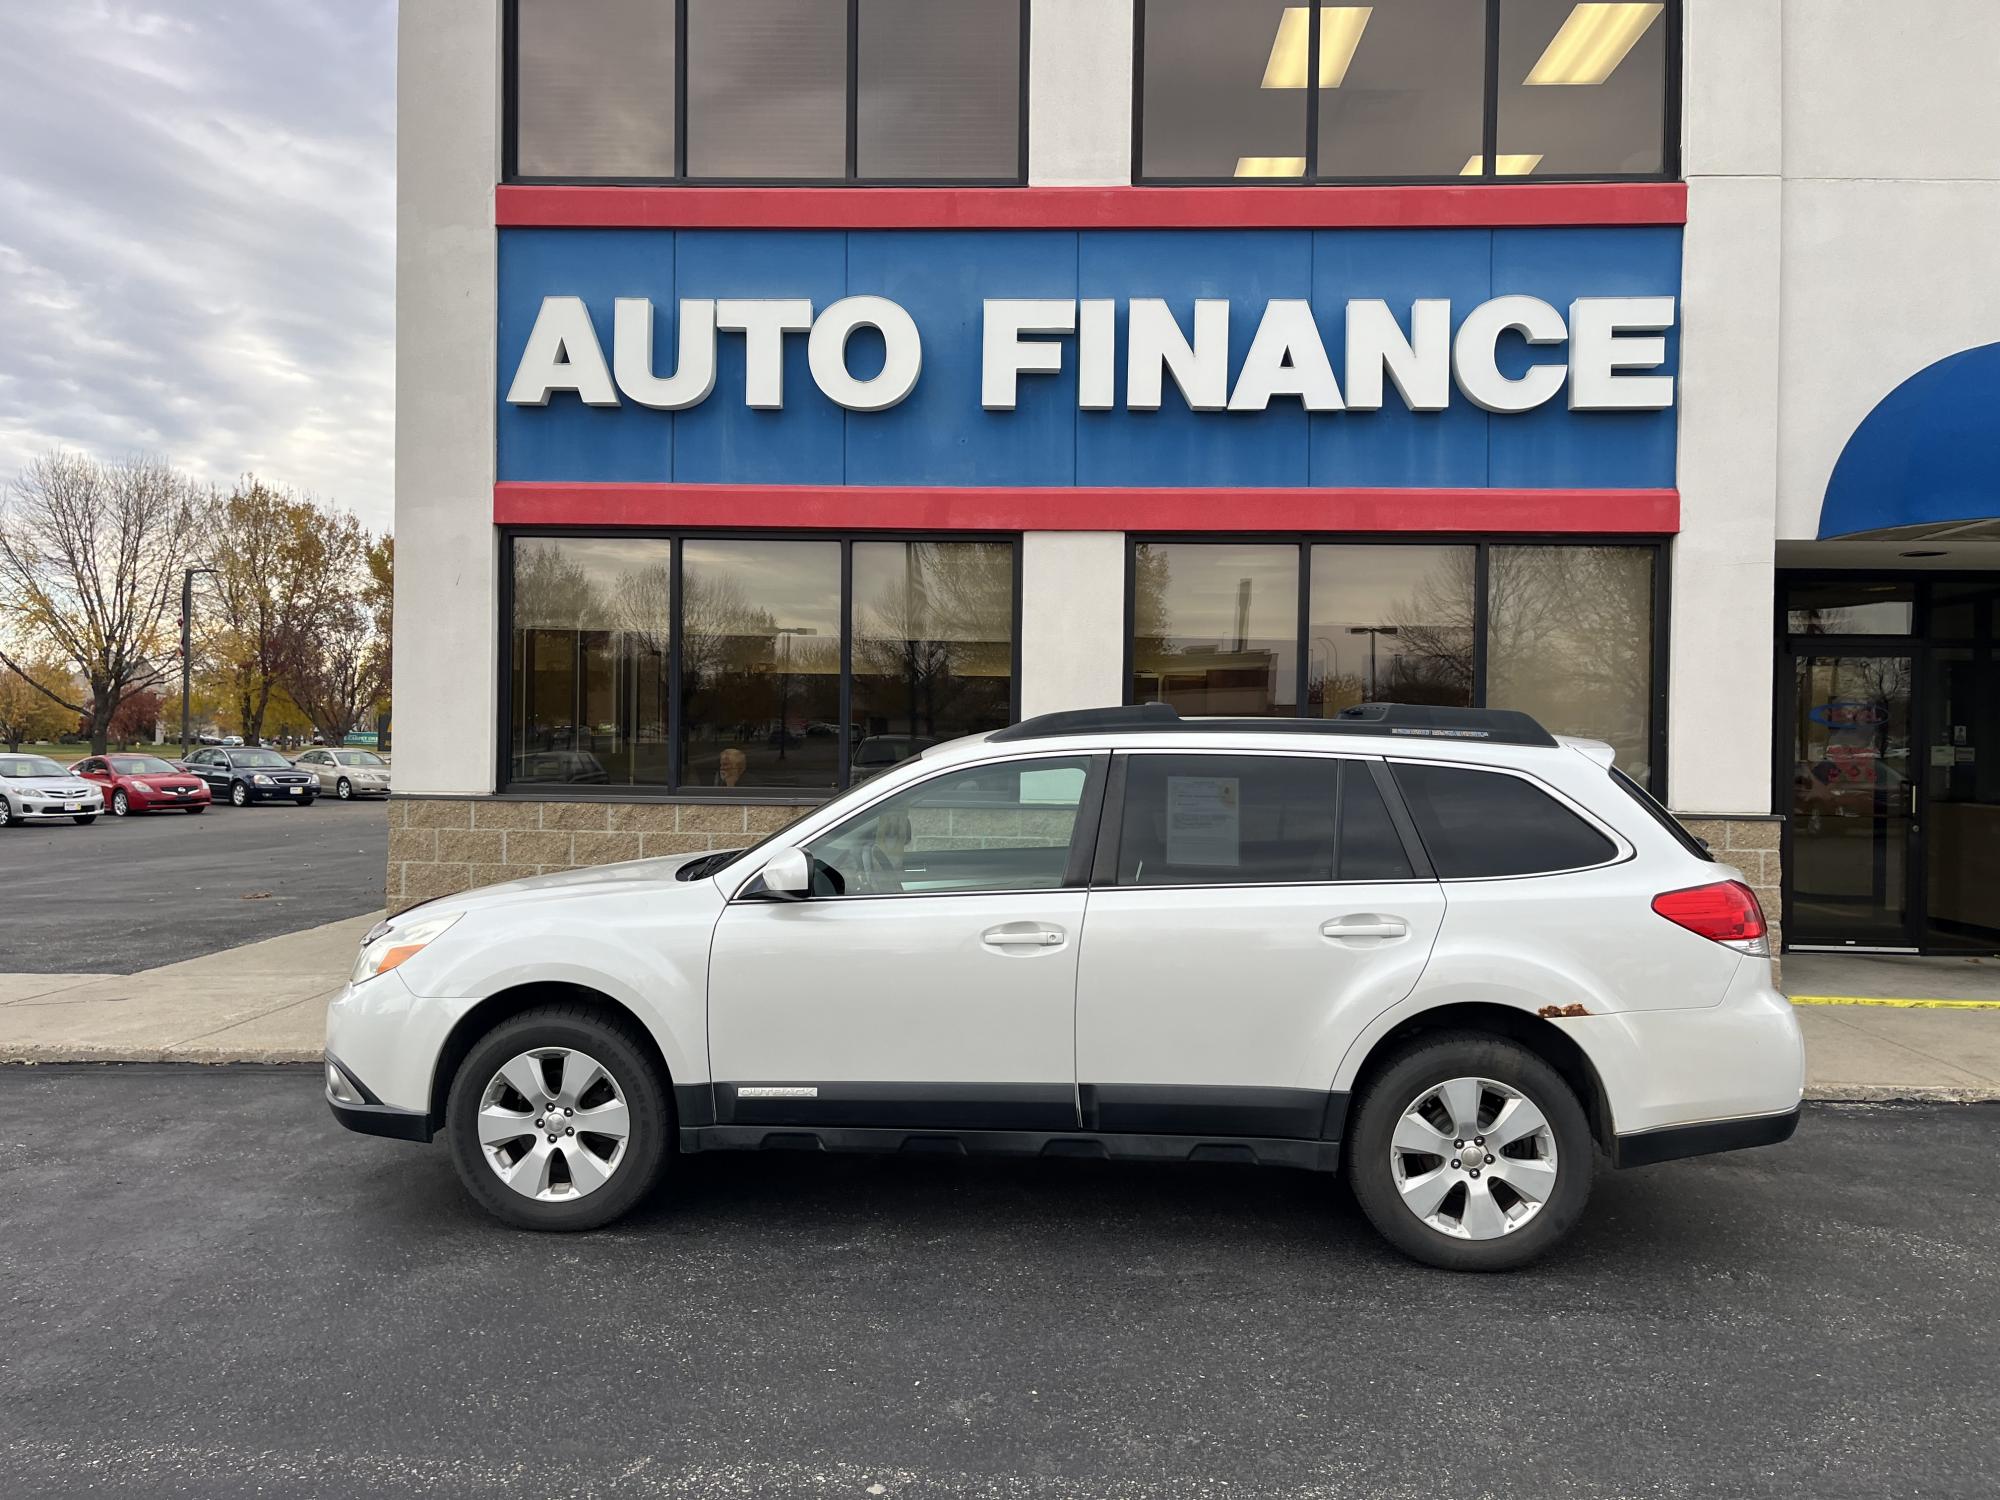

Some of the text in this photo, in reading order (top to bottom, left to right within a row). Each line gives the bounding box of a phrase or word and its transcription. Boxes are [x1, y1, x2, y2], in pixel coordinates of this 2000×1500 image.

[506, 295, 1675, 413] AUTO FINANCE
[738, 1088, 817, 1097] OUTBACK
